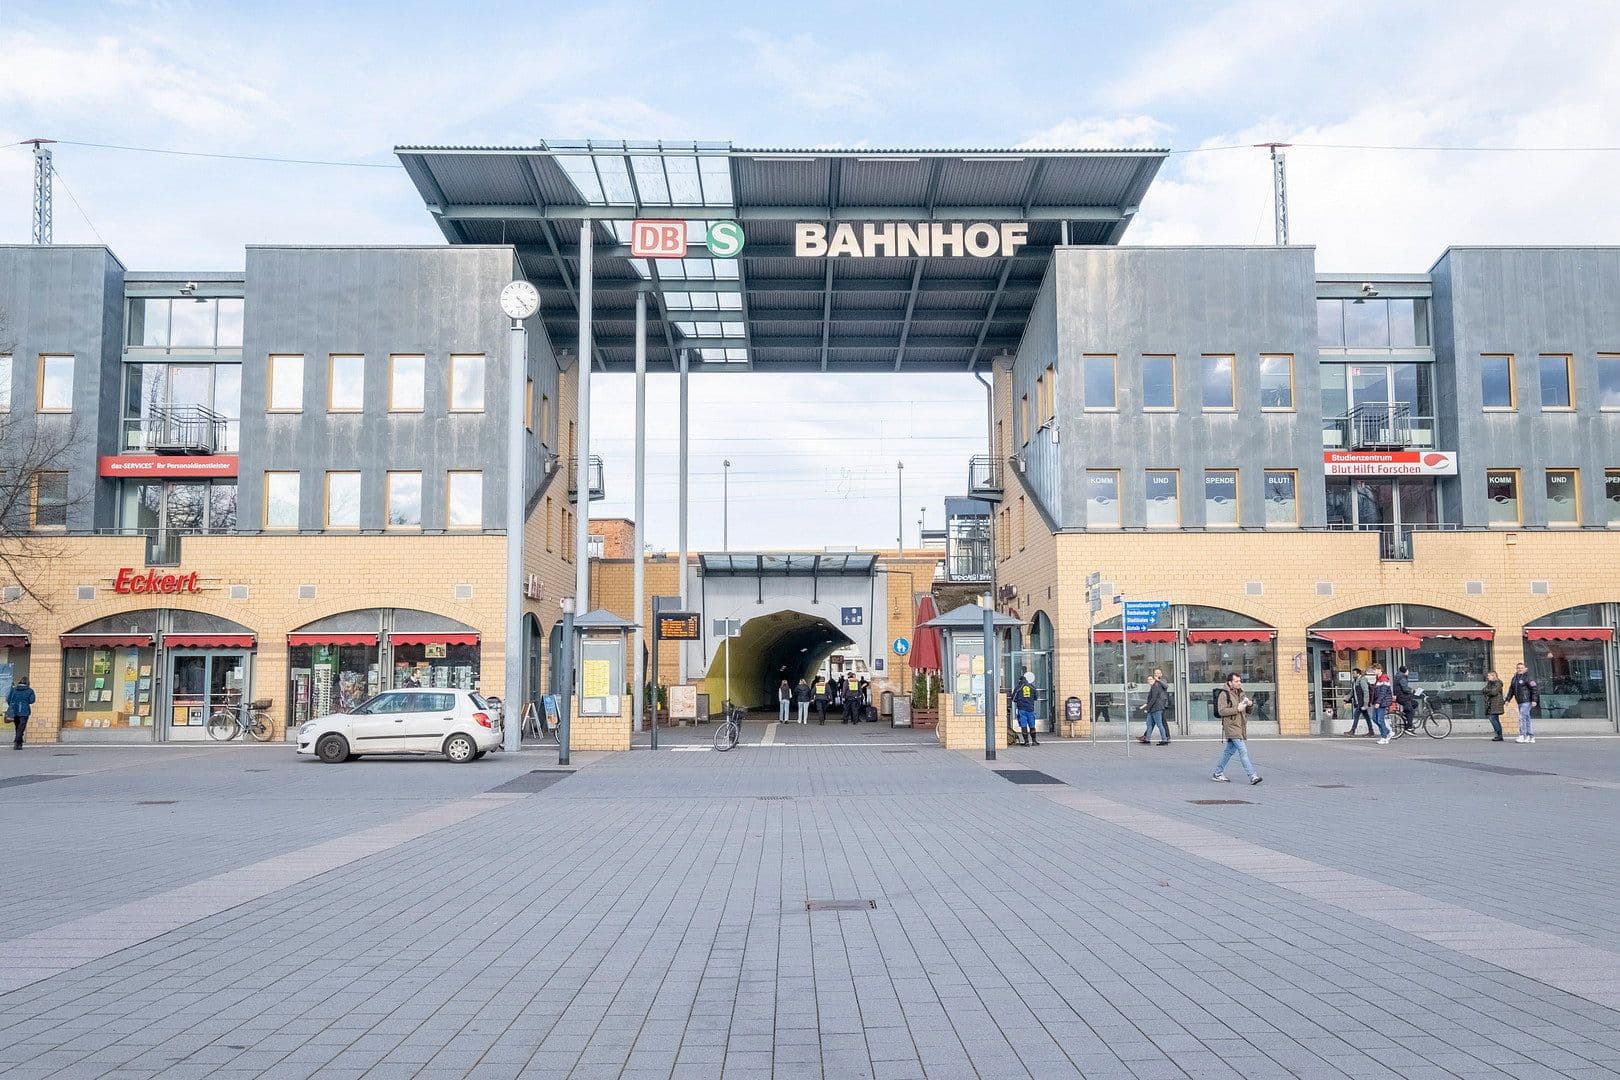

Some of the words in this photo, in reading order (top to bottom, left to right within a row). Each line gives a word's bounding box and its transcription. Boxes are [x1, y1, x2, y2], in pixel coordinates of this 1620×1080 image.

[640, 226, 680, 251] DB
[711, 223, 739, 255] S
[795, 222, 1029, 258] BAHNHOF
[1331, 454, 1393, 462] Studienzentrum
[1331, 464, 1351, 474] Blut
[1353, 464, 1375, 474] Hilft
[1377, 464, 1421, 474] Forschen
